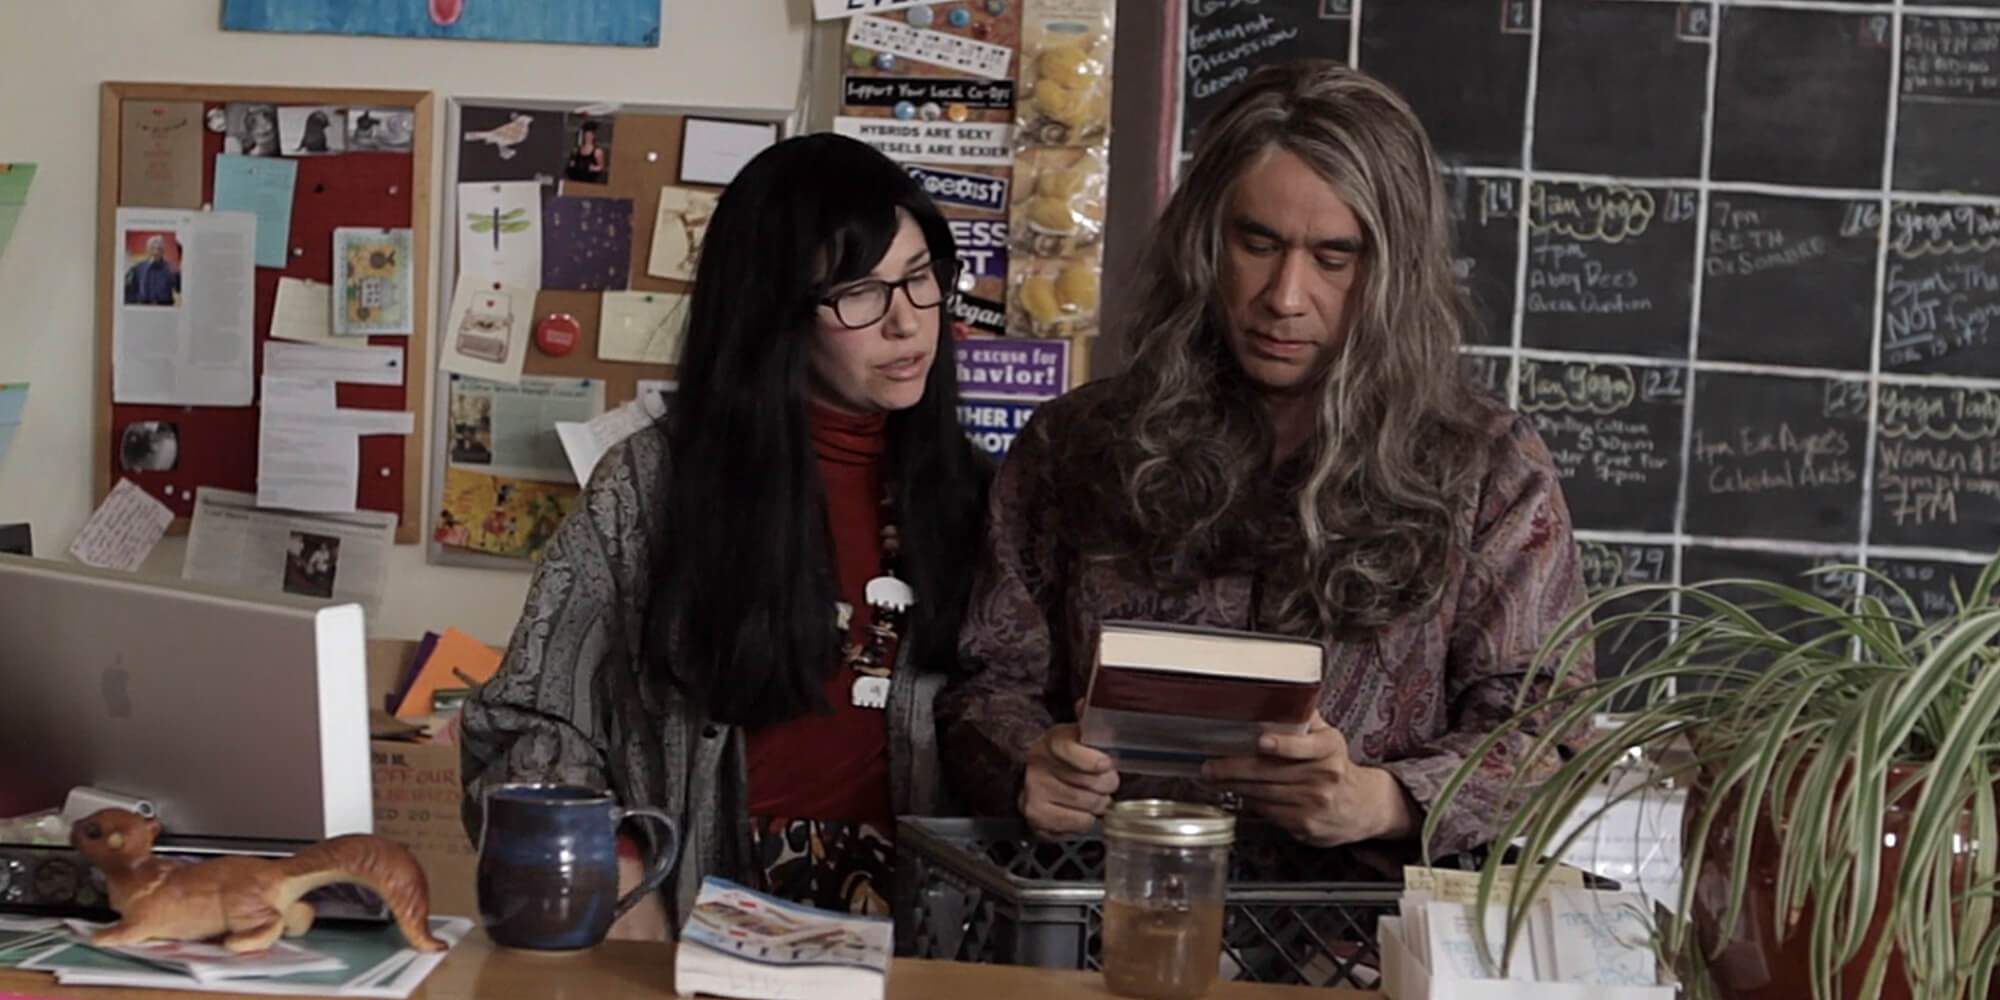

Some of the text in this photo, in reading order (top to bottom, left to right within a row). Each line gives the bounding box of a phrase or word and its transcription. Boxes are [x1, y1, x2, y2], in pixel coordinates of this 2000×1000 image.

[1186, 27, 1299, 78] Discussion
[847, 81, 895, 99] Support
[859, 125, 992, 140] HYBRIDS ARE SEXY
[927, 145, 954, 155] ARE
[959, 145, 1010, 157] SEXIER
[1489, 181, 1513, 211] 14
[1671, 190, 1696, 220] 15
[1708, 229, 1785, 254] BETH
[1886, 298, 1942, 345] NOT
[973, 349, 1028, 364] excuse
[1032, 348, 1057, 365] for
